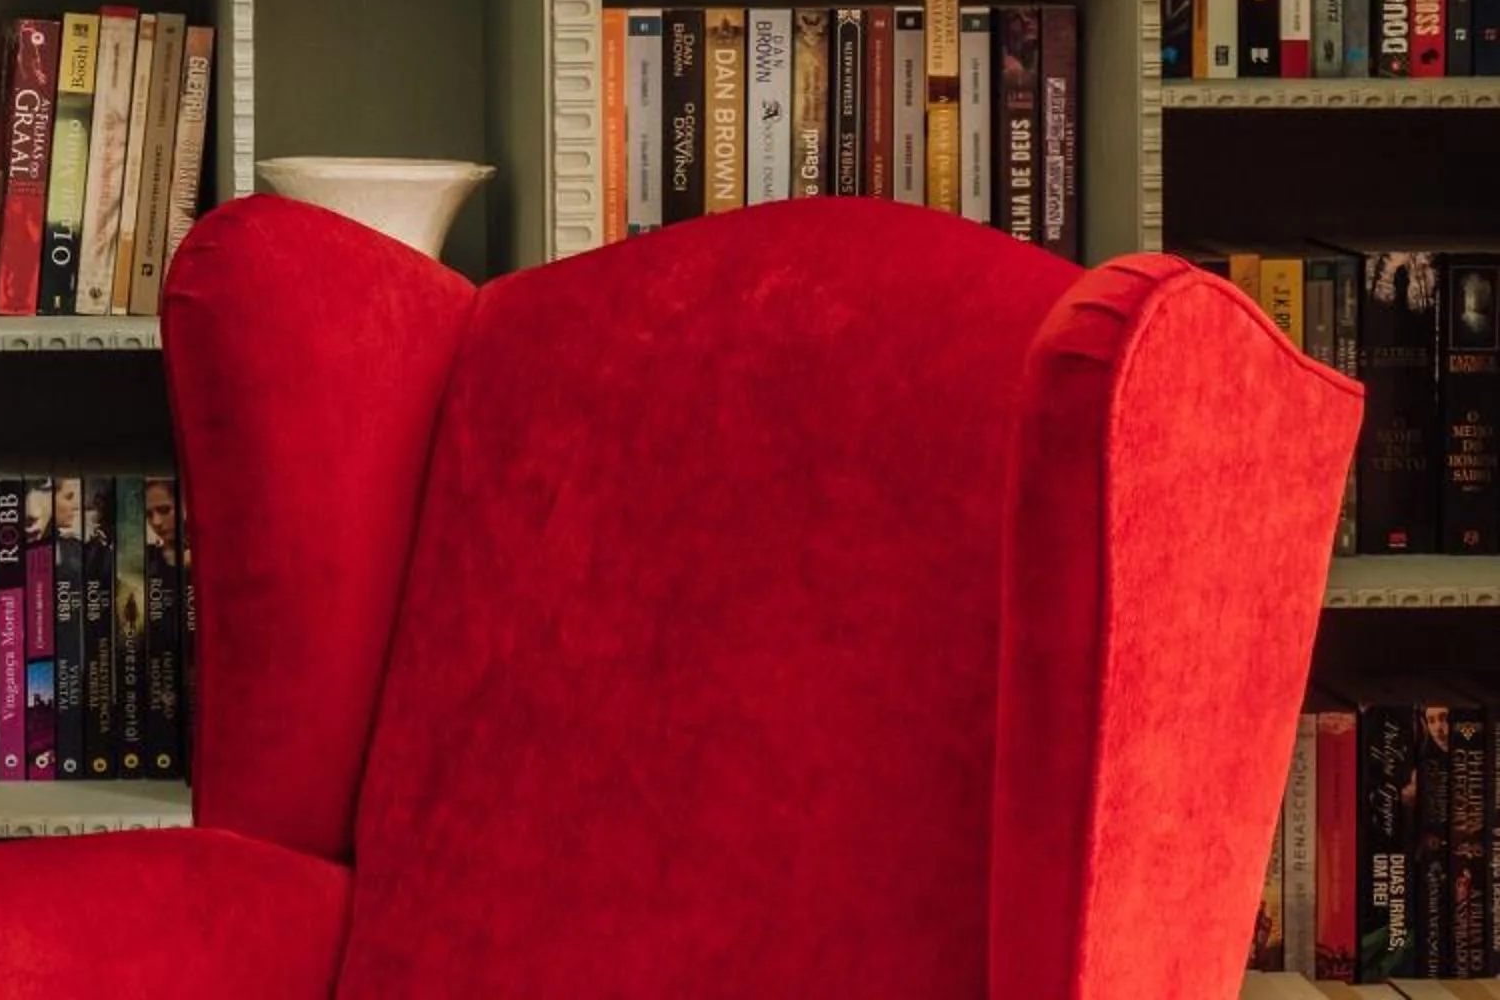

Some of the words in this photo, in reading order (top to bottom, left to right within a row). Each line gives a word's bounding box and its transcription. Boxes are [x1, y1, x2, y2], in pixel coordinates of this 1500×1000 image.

[71, 45, 89, 89] Booth
[672, 22, 684, 77] BROWN
[683, 34, 695, 65] DAN
[756, 20, 772, 83] BROWN
[773, 34, 784, 69] DAN
[714, 48, 738, 99] DAN
[9, 87, 40, 177] GRAAL
[33, 112, 49, 160] FILHAS
[1012, 119, 1031, 161] DEUS
[713, 107, 737, 200] BROWN
[1012, 167, 1031, 188] DE
[51, 246, 71, 266] O
[0, 493, 19, 563] ROBB
[58, 580, 71, 621] ROBB
[88, 580, 101, 621] ROBB
[150, 578, 163, 620] ROBB
[1373, 854, 1388, 877] UM
[1389, 853, 1405, 895] DUAS
[1374, 882, 1388, 906] REI
[1388, 898, 1407, 951] IRMÃS,
